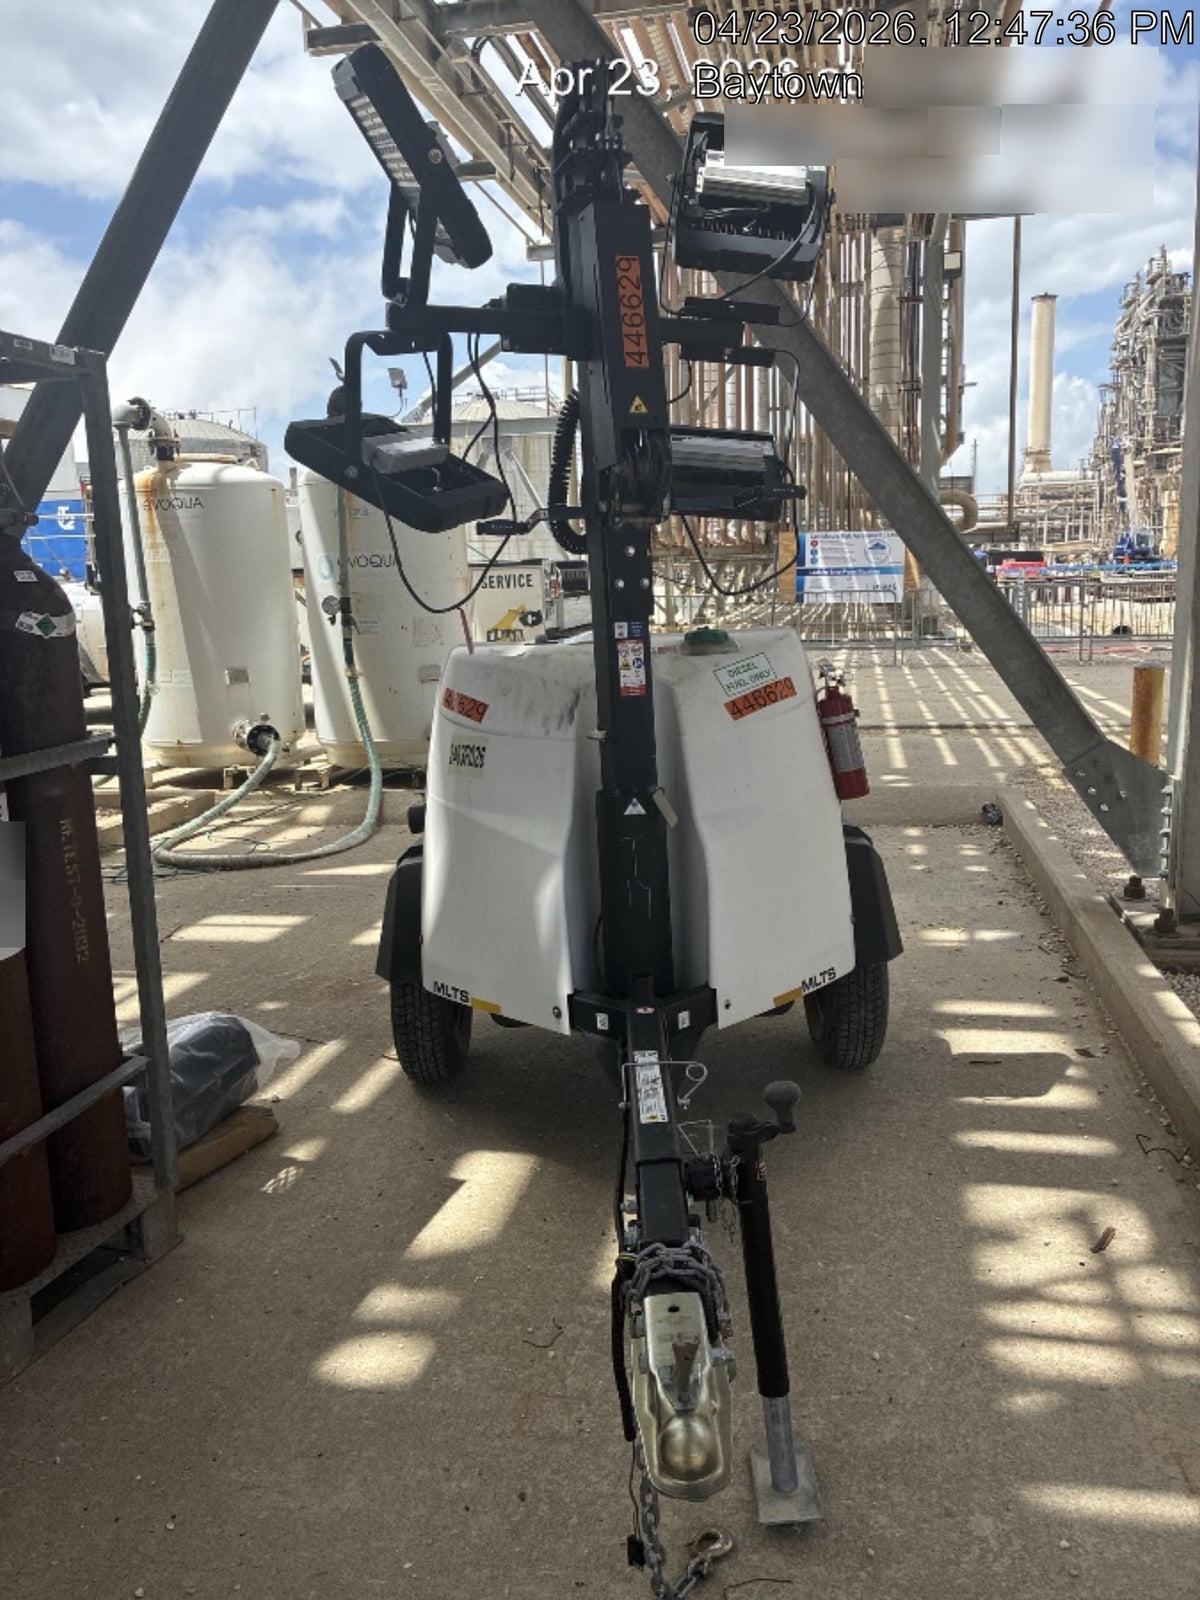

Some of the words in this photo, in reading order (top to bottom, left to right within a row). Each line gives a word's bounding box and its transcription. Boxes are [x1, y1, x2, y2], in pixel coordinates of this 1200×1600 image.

[616, 256, 647, 366] 446629
[337, 553, 400, 568] VOQU
[481, 573, 534, 590] SERVICE
[729, 677, 797, 717] 446629
[433, 980, 470, 1003] MLTS
[801, 966, 837, 993] MLTS
